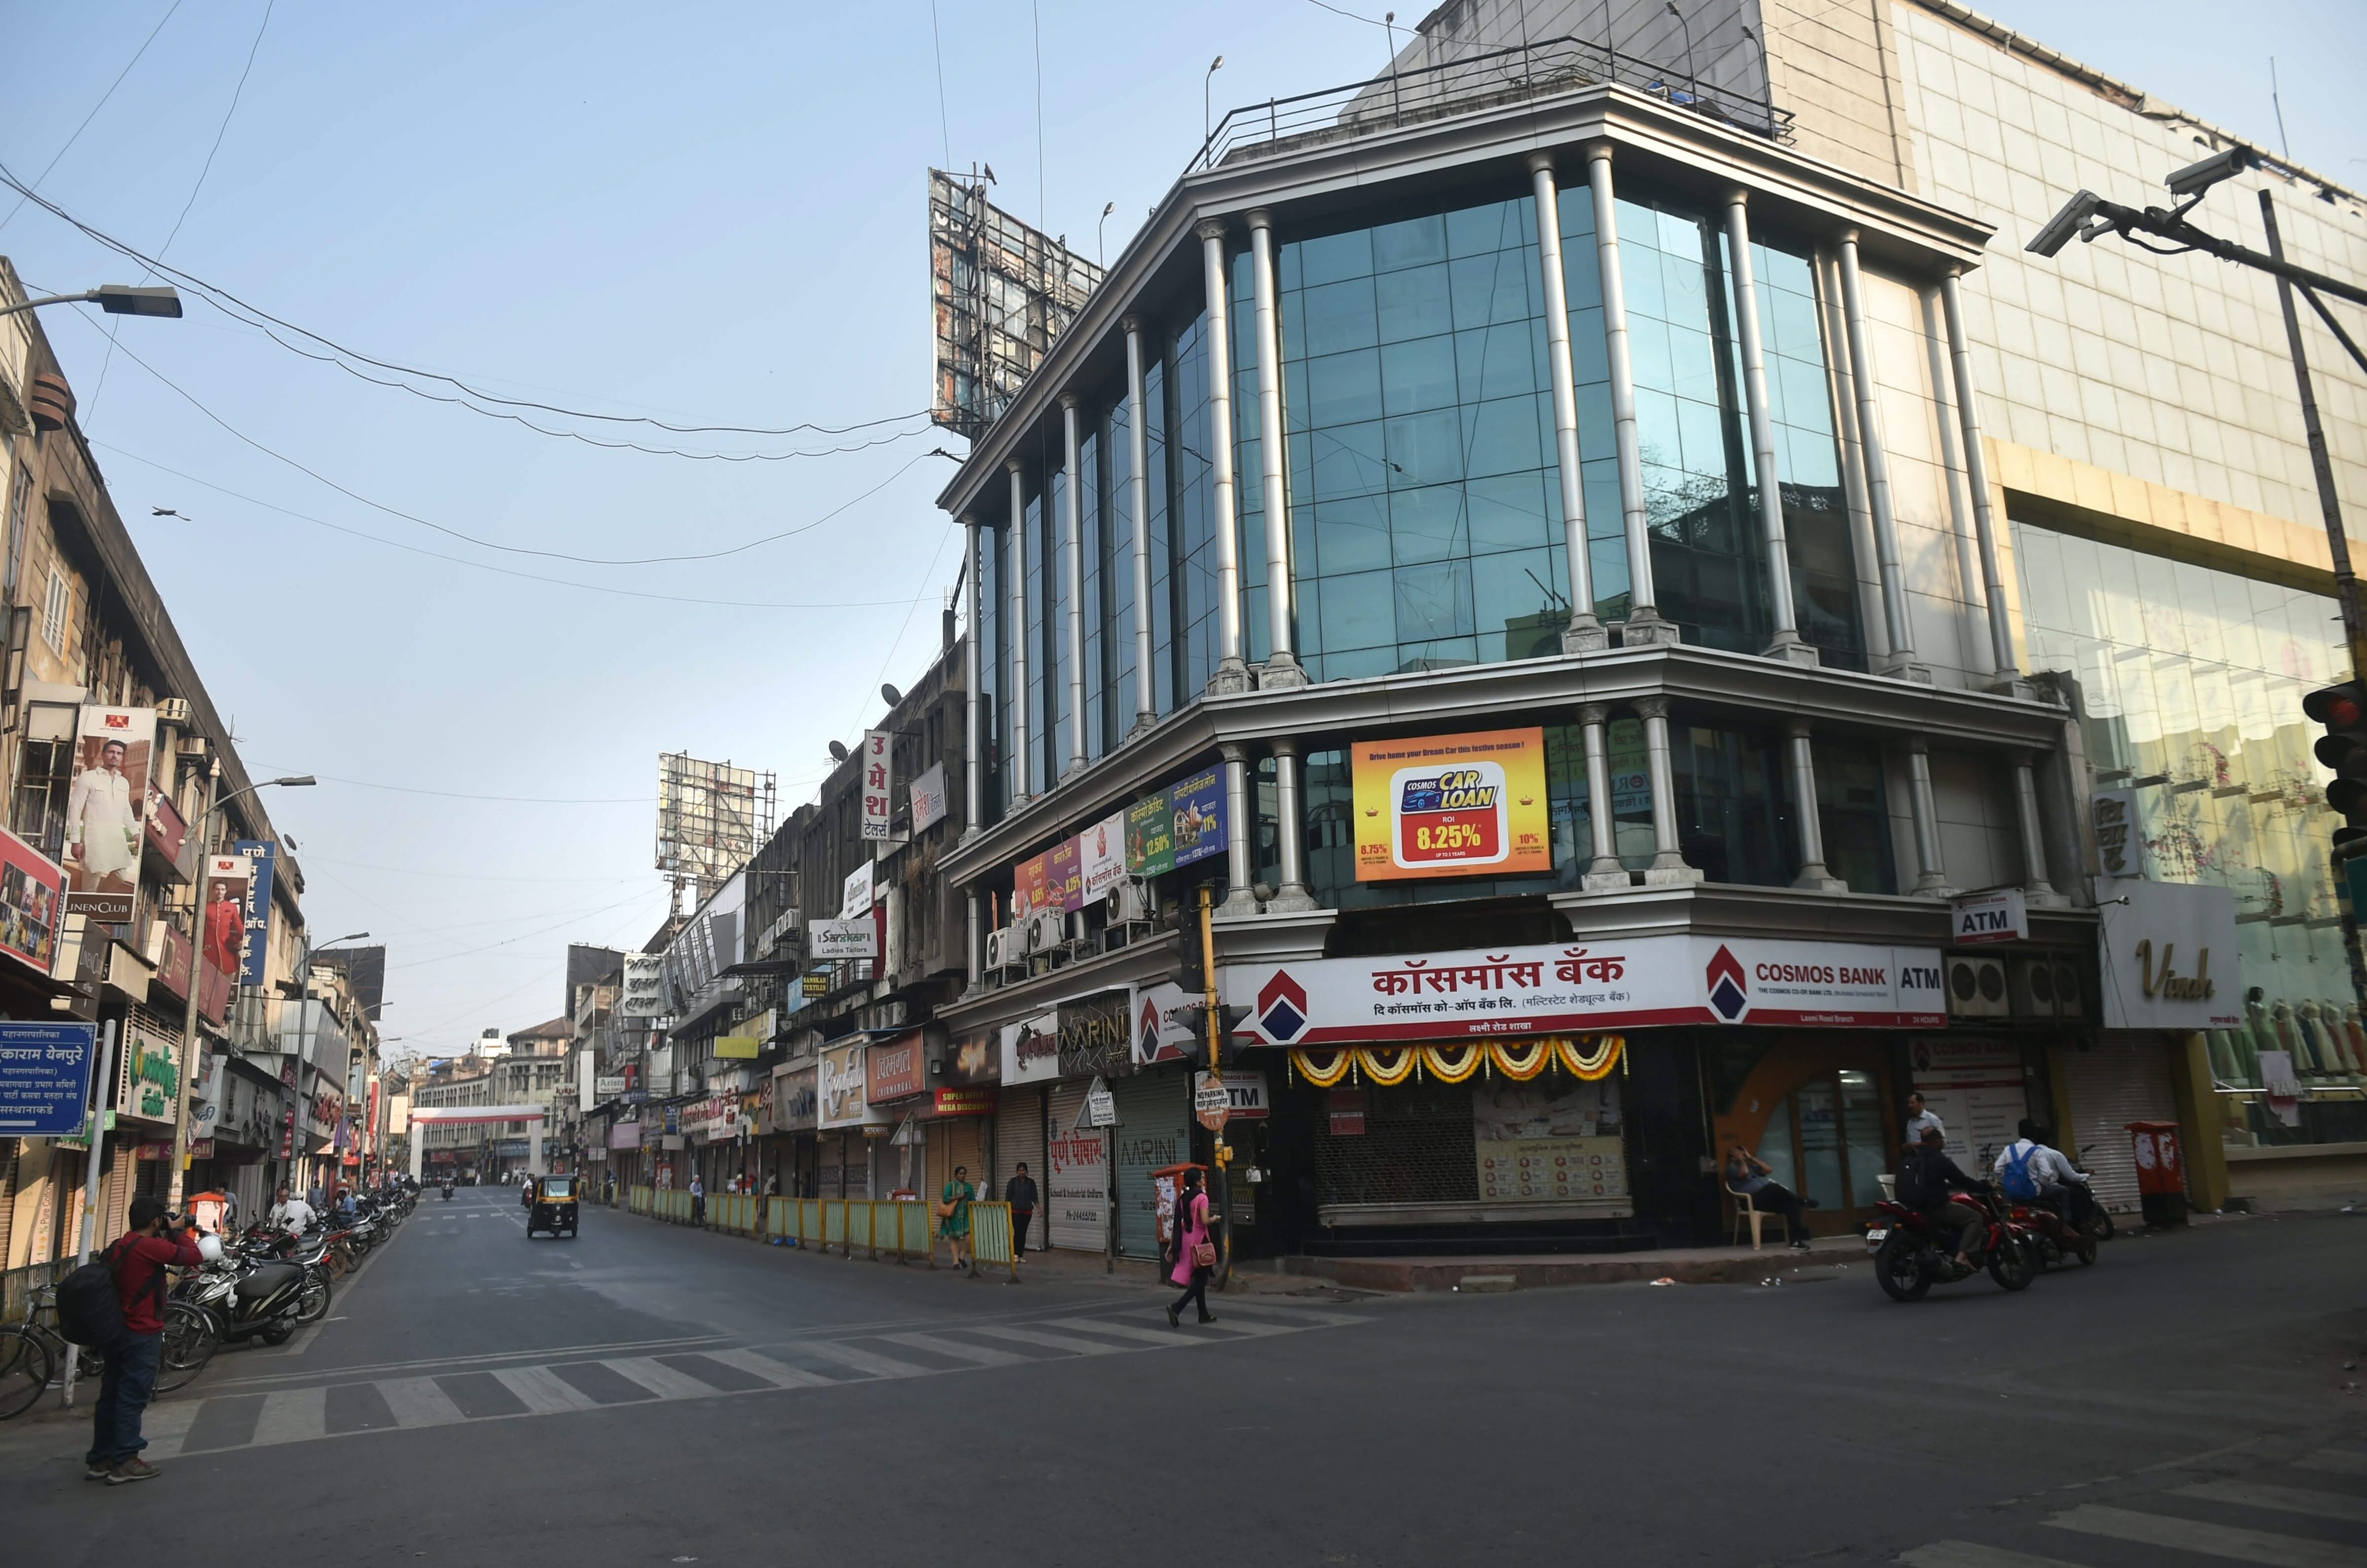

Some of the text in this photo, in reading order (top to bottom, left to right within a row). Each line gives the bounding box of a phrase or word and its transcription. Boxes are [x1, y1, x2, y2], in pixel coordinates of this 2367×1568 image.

[1496, 742, 1520, 750] season
[1407, 781, 1436, 790] COSMOS
[1439, 771, 1479, 790] CAR
[1440, 787, 1493, 809] LOAN
[1962, 910, 2008, 932] ATM
[1372, 954, 1544, 996] कॉसमॉस
[1756, 963, 1886, 985] COSMOS BANK
[1901, 967, 1940, 989] ATM
[1374, 1005, 1386, 1016] दि
[1388, 1002, 1431, 1015] कॉसमॉस
[2, 1030, 60, 1039] महानगरपालिका
[1469, 1021, 1532, 1033] लक्ष्मी रोड शाखा
[46, 1045, 84, 1066] येनपुरे
[877, 1080, 912, 1098] CHIRMANGAL
[942, 1091, 984, 1101] SUPER OFFER
[1204, 1089, 1224, 1099] PARKING
[1226, 1089, 1259, 1105] TM
[938, 1103, 988, 1112] MEGA DISCOUNT
[1121, 1137, 1177, 1166] AARINI
[40, 1208, 49, 1225] Pure
